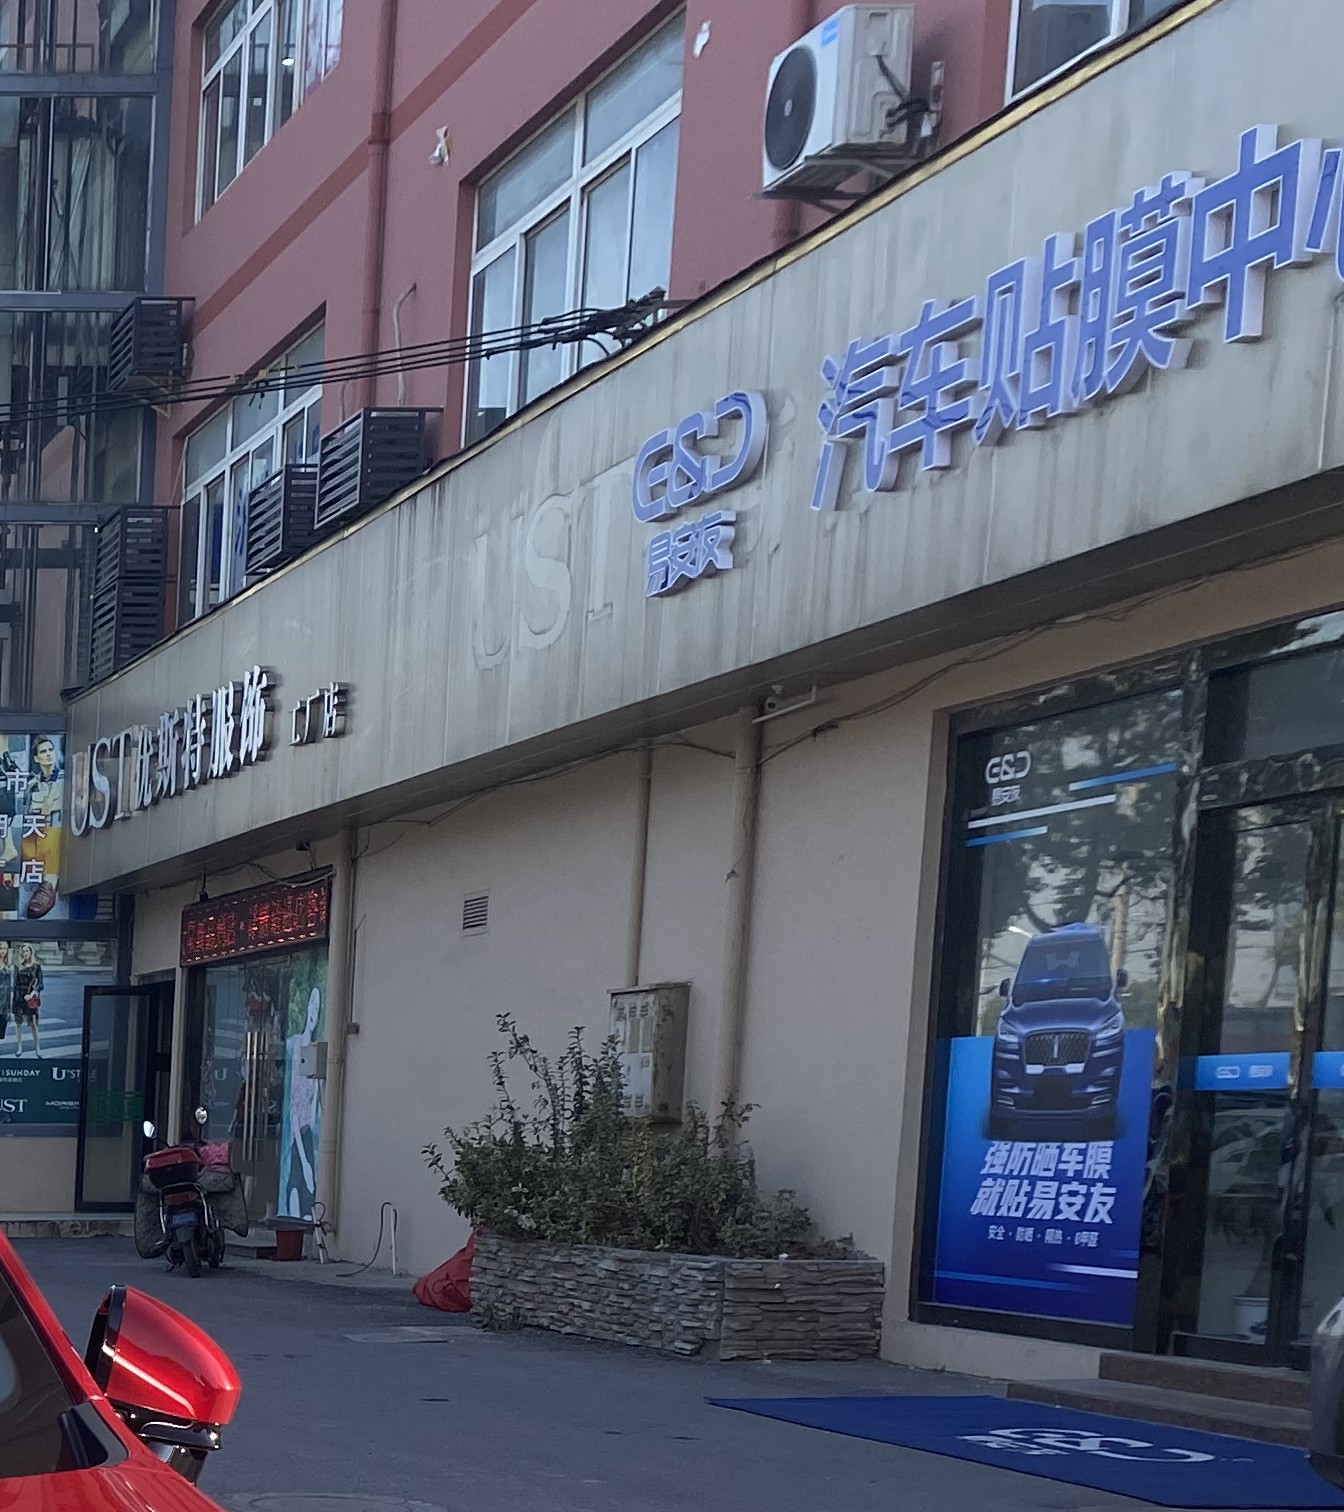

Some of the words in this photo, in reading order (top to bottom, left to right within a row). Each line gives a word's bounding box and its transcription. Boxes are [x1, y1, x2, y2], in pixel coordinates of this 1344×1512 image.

[646, 510, 736, 598] 易安友
[289, 682, 349, 745] 工厂店
[979, 1140, 1114, 1180] 强防晒车膜
[969, 1177, 1118, 1224] 就贴易安友
